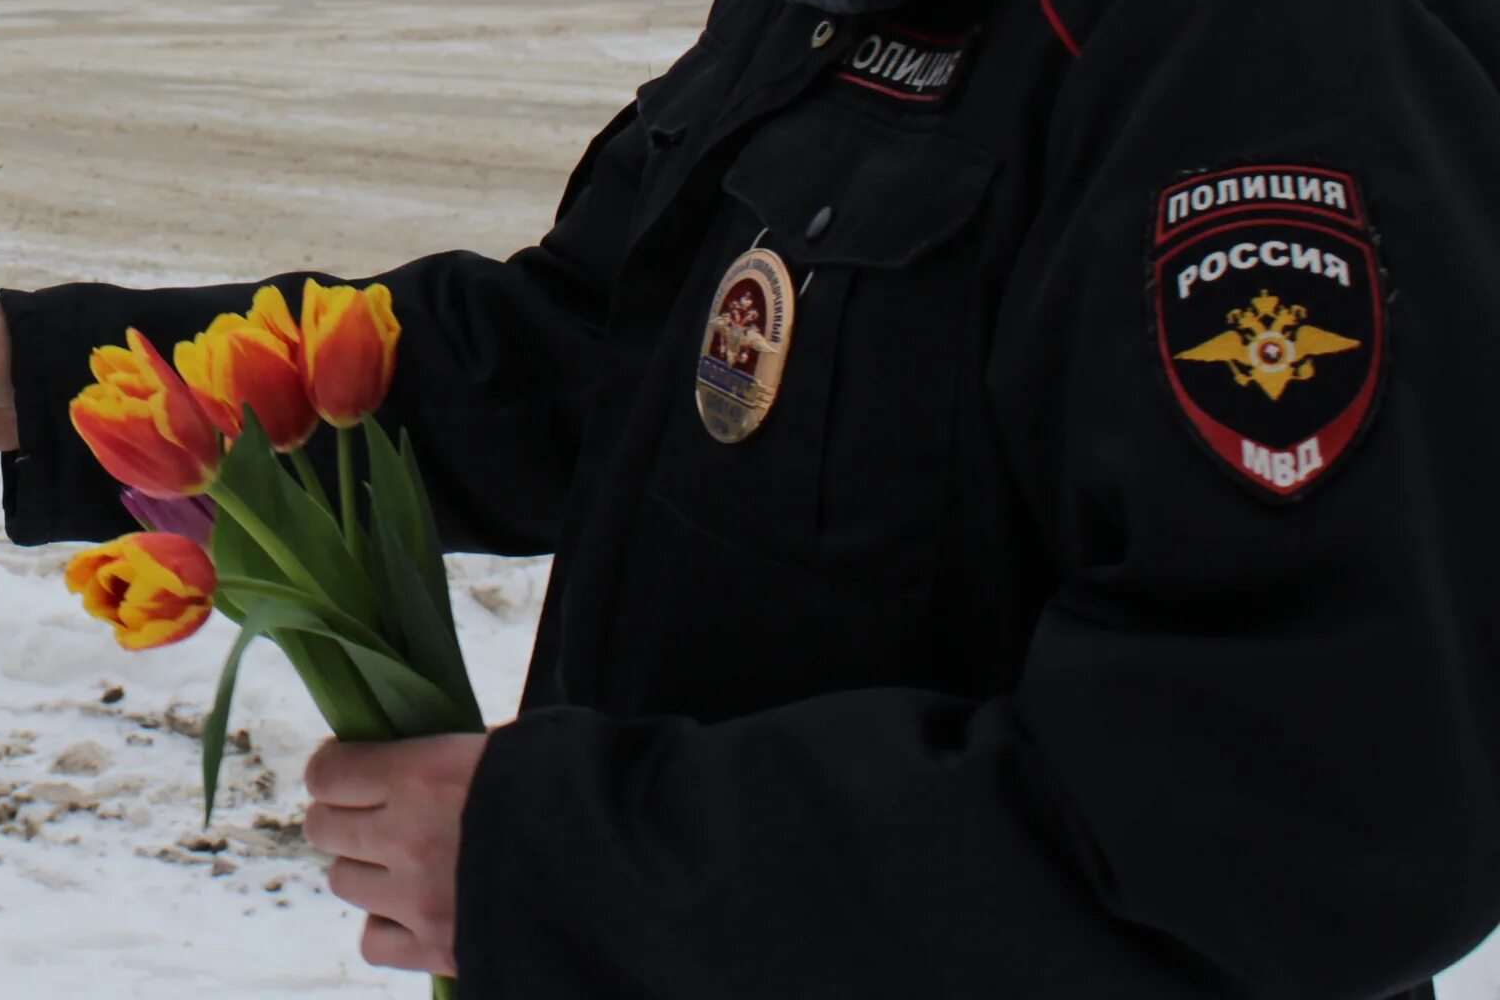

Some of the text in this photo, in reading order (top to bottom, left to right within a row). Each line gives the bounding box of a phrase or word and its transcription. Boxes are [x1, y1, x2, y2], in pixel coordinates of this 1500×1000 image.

[845, 34, 962, 92] ОЛИЦИЯ
[1168, 175, 1348, 224] ПОЛИЦИЯ
[1177, 241, 1350, 299] РОССИЯ
[1241, 436, 1323, 488] МВД
